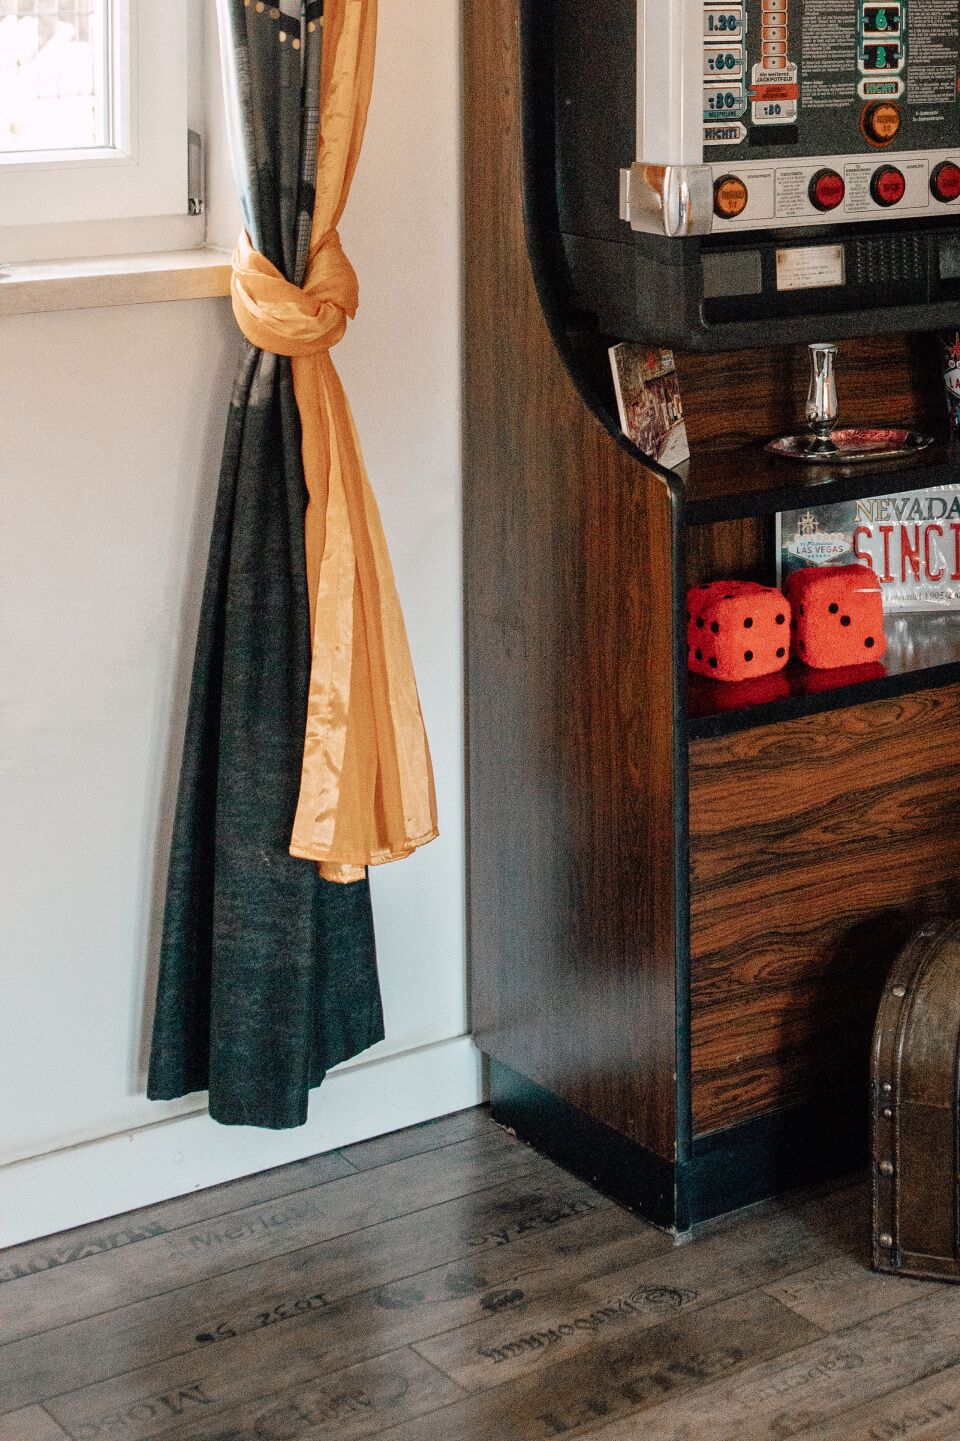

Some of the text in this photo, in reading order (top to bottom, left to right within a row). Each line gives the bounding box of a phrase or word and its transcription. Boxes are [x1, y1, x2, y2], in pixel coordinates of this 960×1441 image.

[708, 14, 738, 32] 1.20
[875, 8, 888, 30] 6
[875, 46, 887, 68] 3
[796, 546, 843, 554] LAS VEGAS
